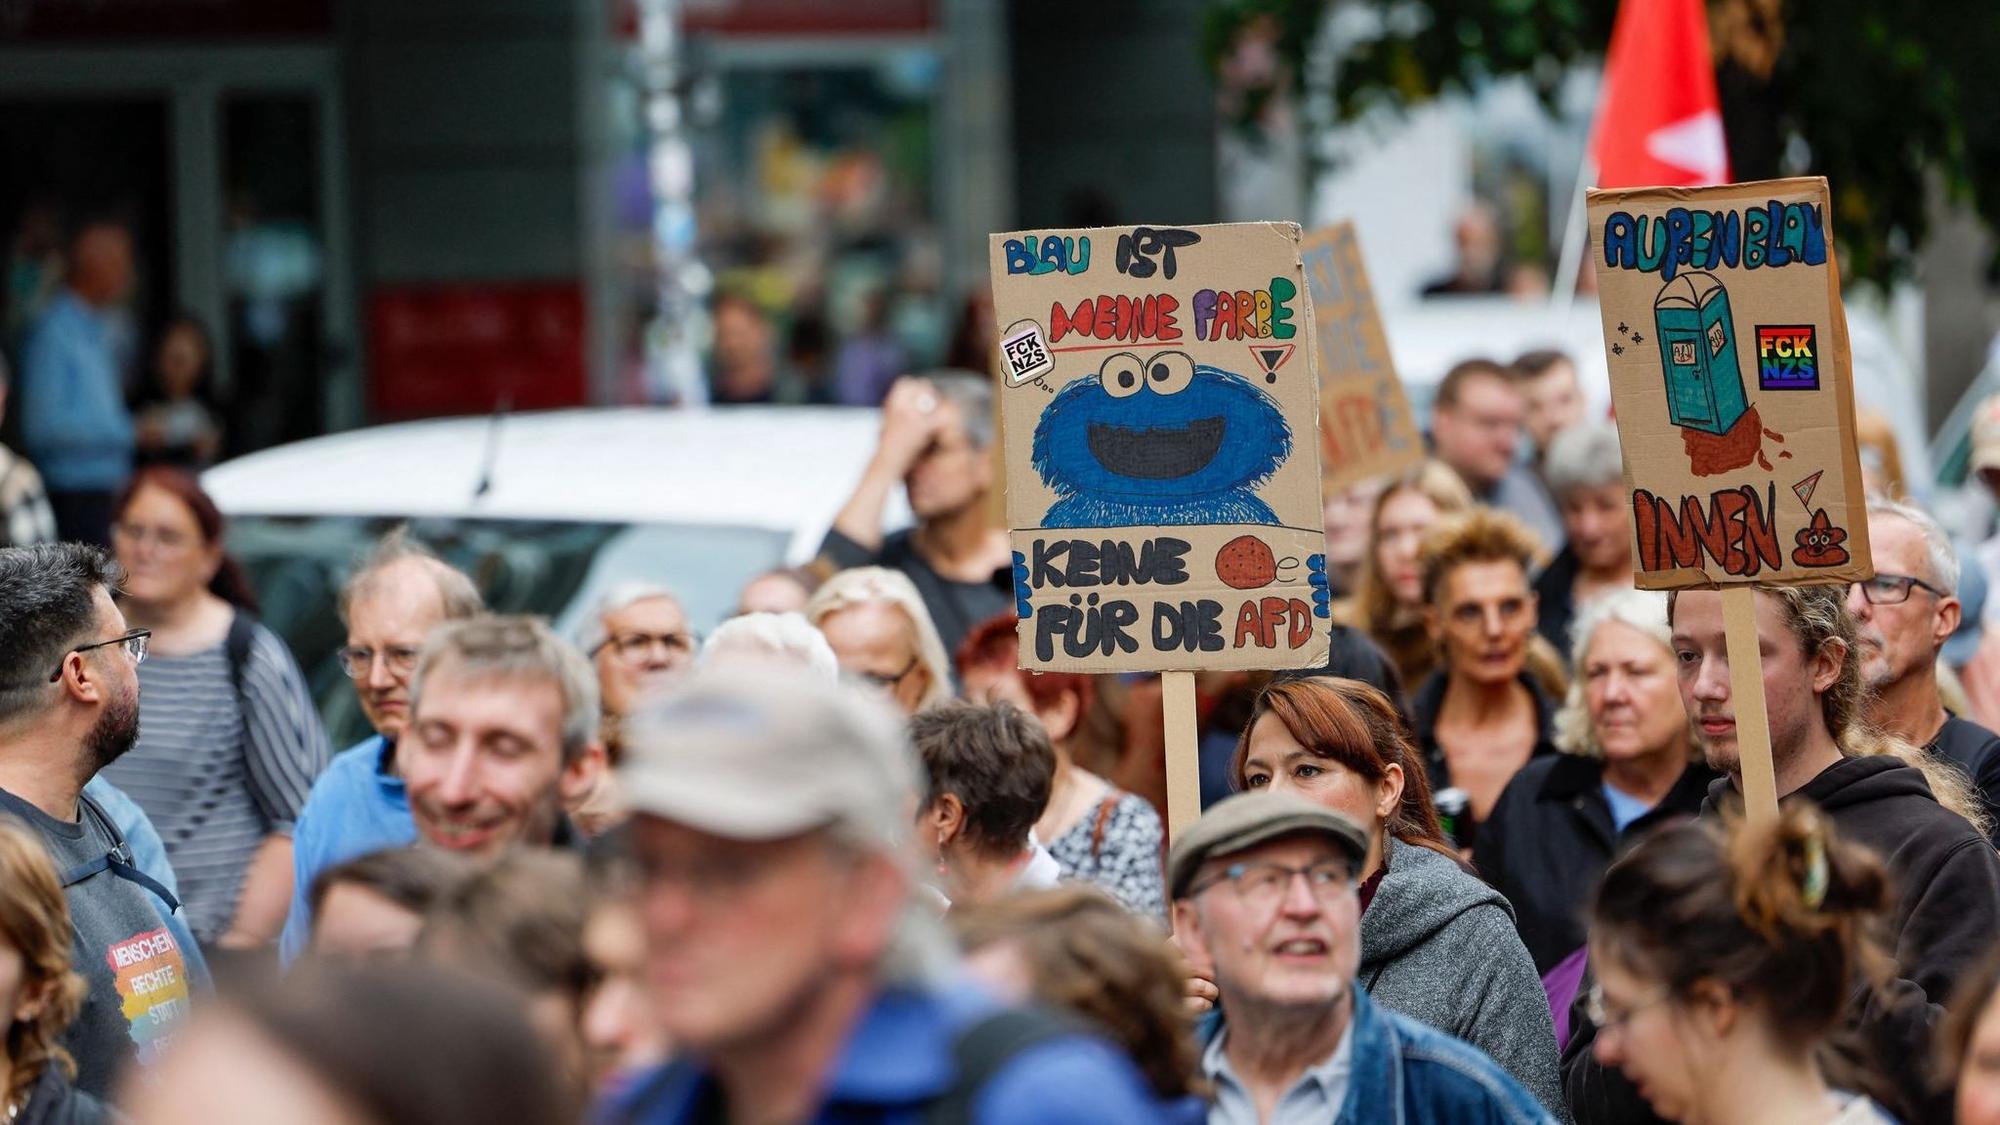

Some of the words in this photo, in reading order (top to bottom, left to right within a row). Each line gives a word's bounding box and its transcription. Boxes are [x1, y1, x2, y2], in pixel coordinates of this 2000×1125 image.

[1003, 235, 1090, 275] BLAU
[1116, 227, 1201, 280] IST
[1050, 293, 1183, 343] MEINE
[1193, 277, 1297, 341] FARBE
[1006, 335, 1041, 360] FCK
[1011, 348, 1046, 373] NZS
[1760, 336, 1813, 358] FCK
[1762, 358, 1815, 380] NZS
[1633, 480, 1782, 576] INNEN
[1032, 537, 1192, 589] KEINE
[1035, 592, 1139, 662] FÜR
[1152, 599, 1226, 652] DIE
[1233, 596, 1313, 650] AFD
[112, 932, 175, 969] MENSCHEN
[130, 965, 176, 996] RECHTE
